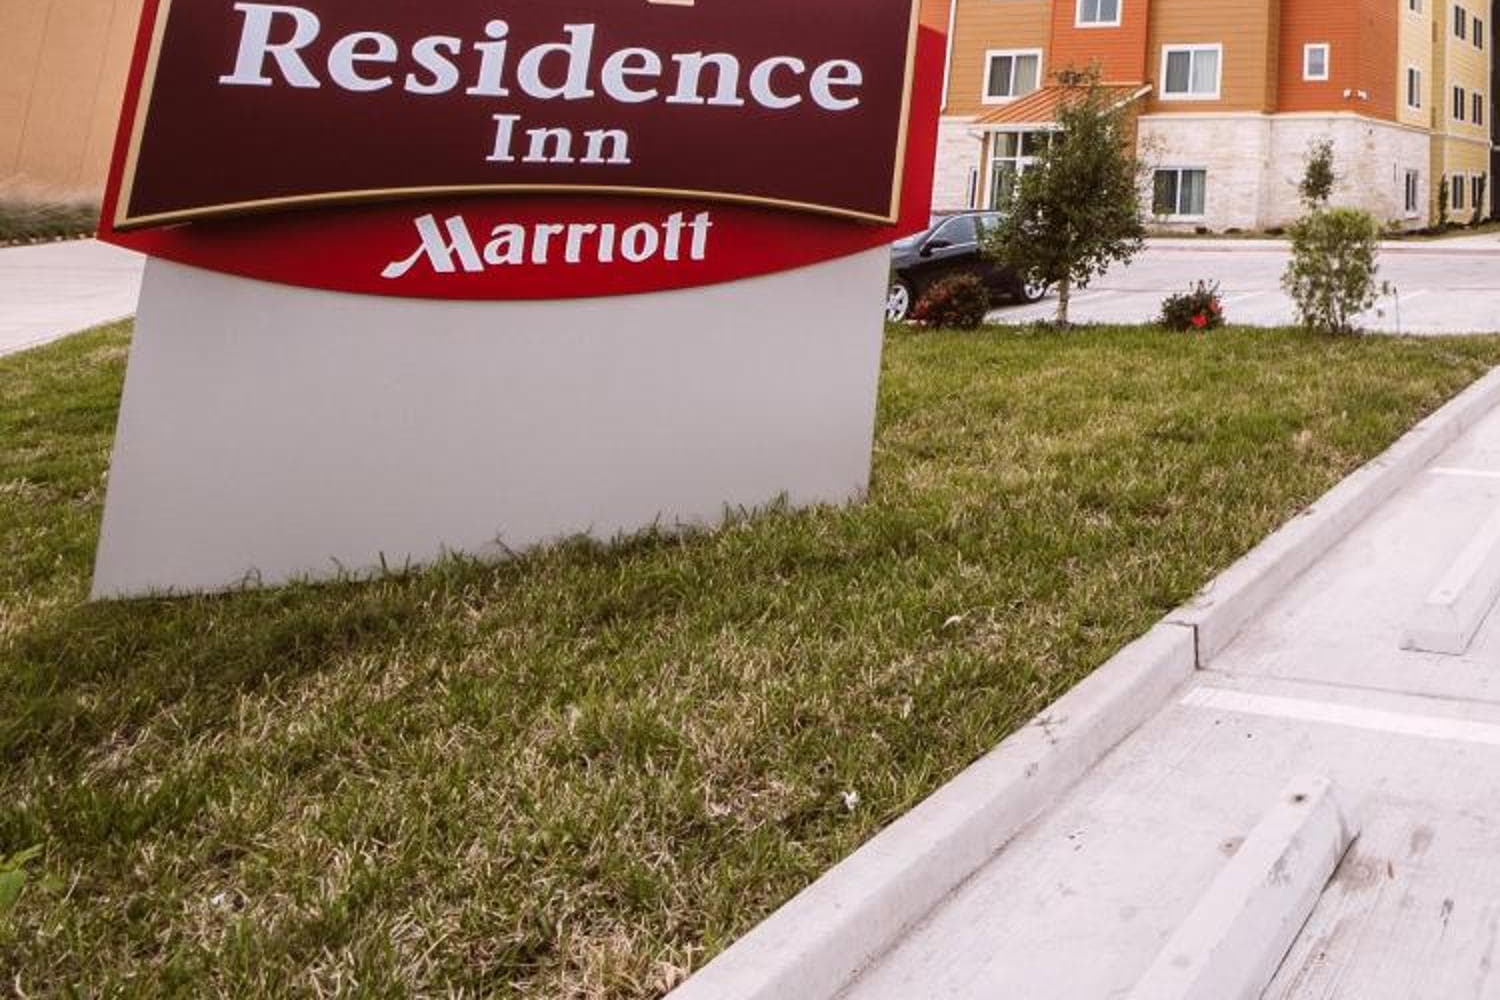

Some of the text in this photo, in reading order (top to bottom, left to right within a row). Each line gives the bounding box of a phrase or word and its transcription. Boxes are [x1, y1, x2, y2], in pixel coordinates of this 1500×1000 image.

[219, 2, 863, 111] Residence
[486, 114, 631, 165] Inn
[381, 212, 713, 279] Marriott
